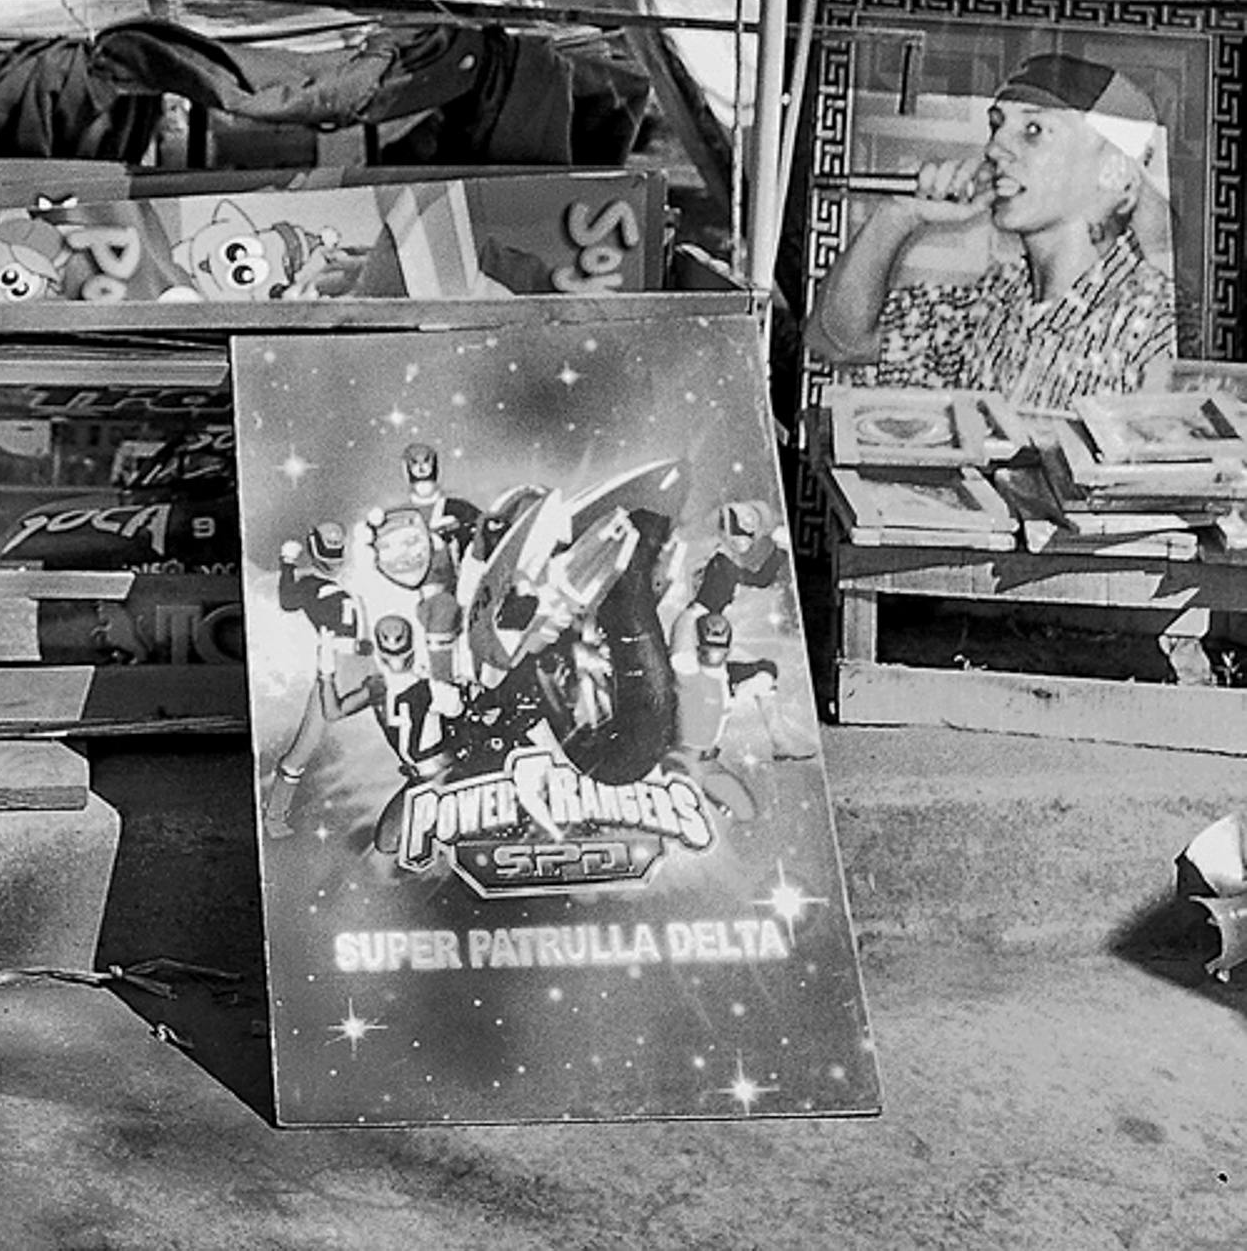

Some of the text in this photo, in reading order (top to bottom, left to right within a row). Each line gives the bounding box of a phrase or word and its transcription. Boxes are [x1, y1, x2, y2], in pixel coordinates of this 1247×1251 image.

[333, 919, 790, 972] SUPER PATRULLA DELTA
